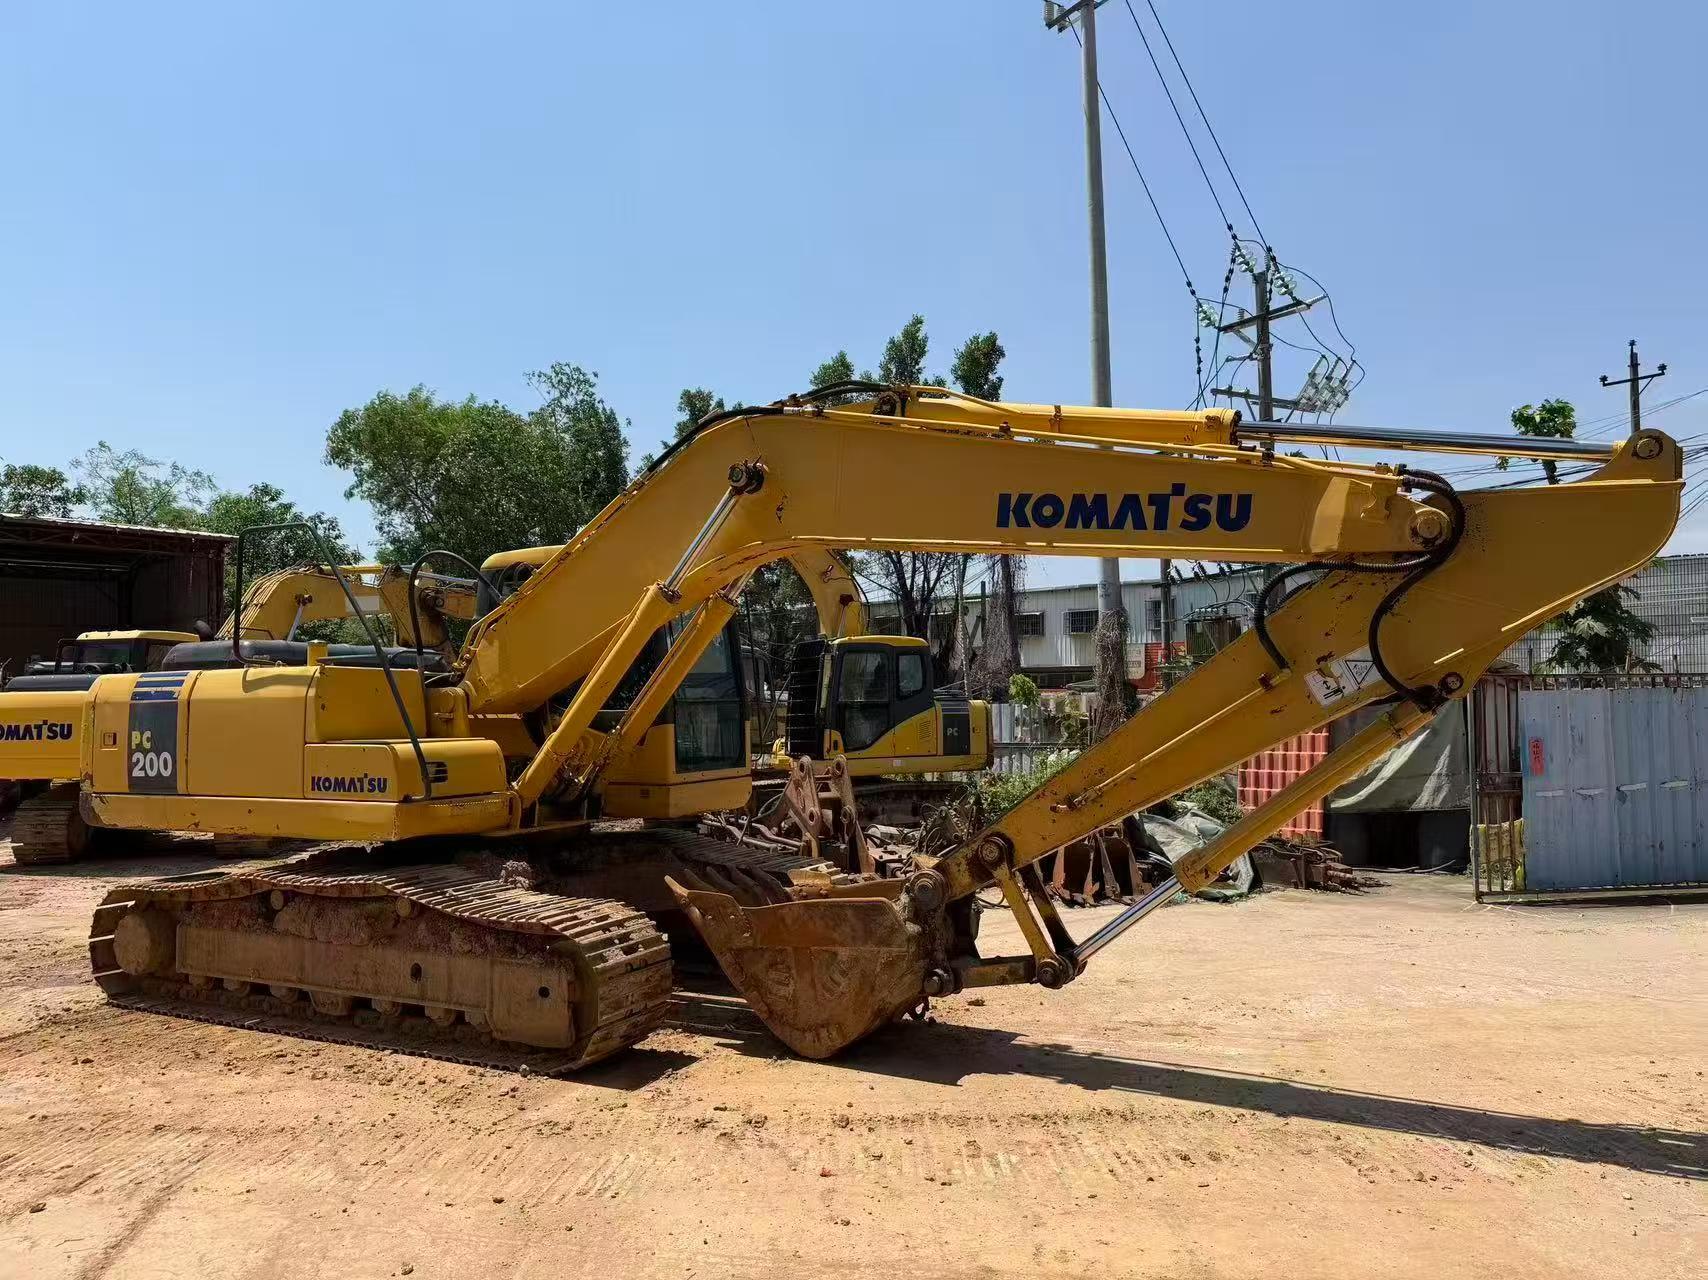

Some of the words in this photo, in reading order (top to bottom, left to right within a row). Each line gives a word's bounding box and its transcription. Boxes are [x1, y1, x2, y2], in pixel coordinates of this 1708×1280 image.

[996, 483, 1253, 532] KOMATSU
[131, 730, 152, 749] PC
[947, 728, 959, 736] PC
[131, 751, 173, 777] 200
[311, 773, 388, 793] KOMATSU
